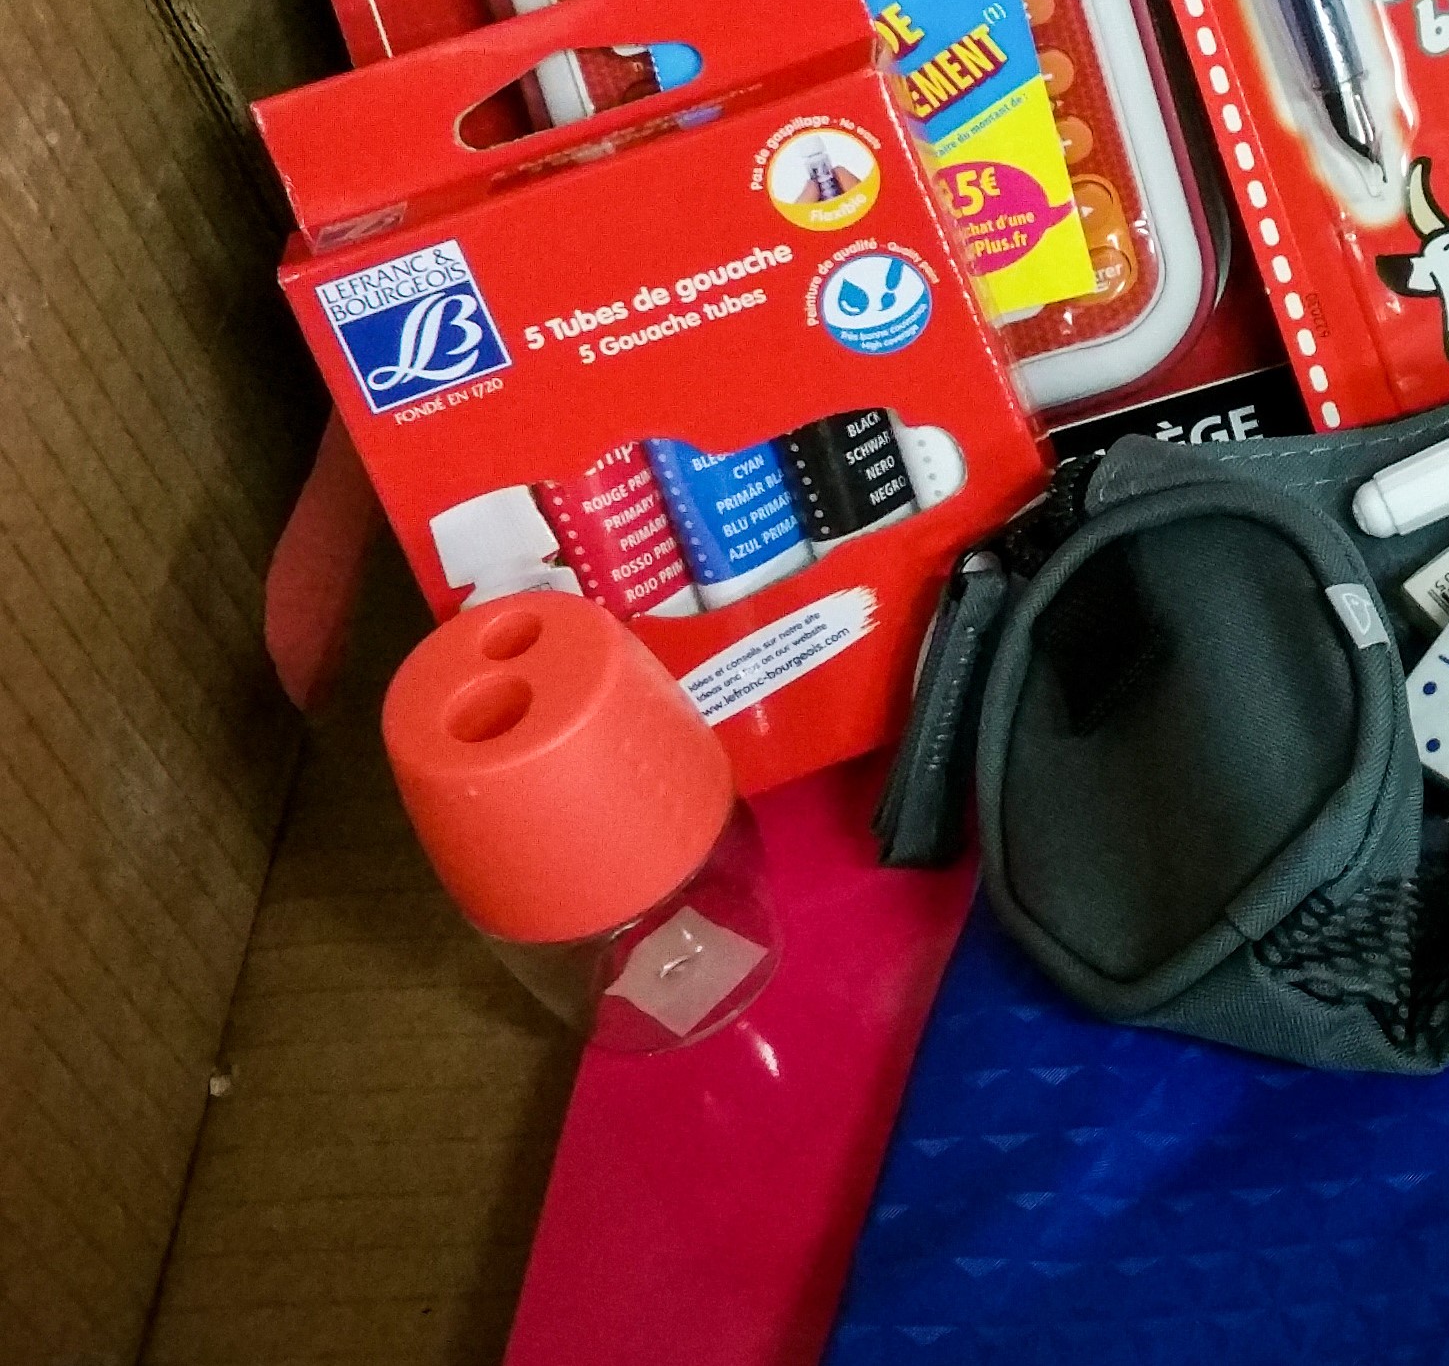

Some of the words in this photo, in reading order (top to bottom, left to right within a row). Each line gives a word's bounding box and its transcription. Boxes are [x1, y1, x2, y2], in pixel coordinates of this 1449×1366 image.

[750, 168, 764, 191] Pas
[766, 115, 830, 150] gaspillage
[996, 211, 1035, 232] d'une
[833, 238, 878, 261] qualité
[321, 251, 432, 308] LEFRANC
[433, 248, 452, 267] &
[331, 260, 469, 325] BOURGEOIS
[523, 323, 546, 352] 5
[549, 300, 629, 344] Tubes
[632, 283, 672, 316] de
[673, 240, 794, 309] gouache
[579, 341, 597, 365] 5
[598, 308, 703, 362] Gouache
[703, 285, 767, 327] tubes
[393, 392, 446, 427] FONDÉ
[447, 387, 470, 409] EN
[471, 376, 504, 402] 1720
[845, 410, 883, 438] BLACK
[732, 454, 764, 480] CYAN
[864, 454, 897, 482] NERO
[582, 484, 628, 515] ROUGE
[868, 475, 908, 508] NEGRO
[603, 494, 655, 534] PRIMARY
[722, 517, 749, 539] BLU
[729, 538, 762, 562] AZUL
[611, 553, 653, 582] ROSSO
[625, 579, 658, 603] ROJO
[726, 647, 762, 671] conseils
[762, 637, 777, 649] sur
[777, 623, 803, 640] notre
[804, 613, 820, 625] site
[761, 654, 774, 665] on
[775, 646, 790, 657] our
[791, 623, 828, 646] website
